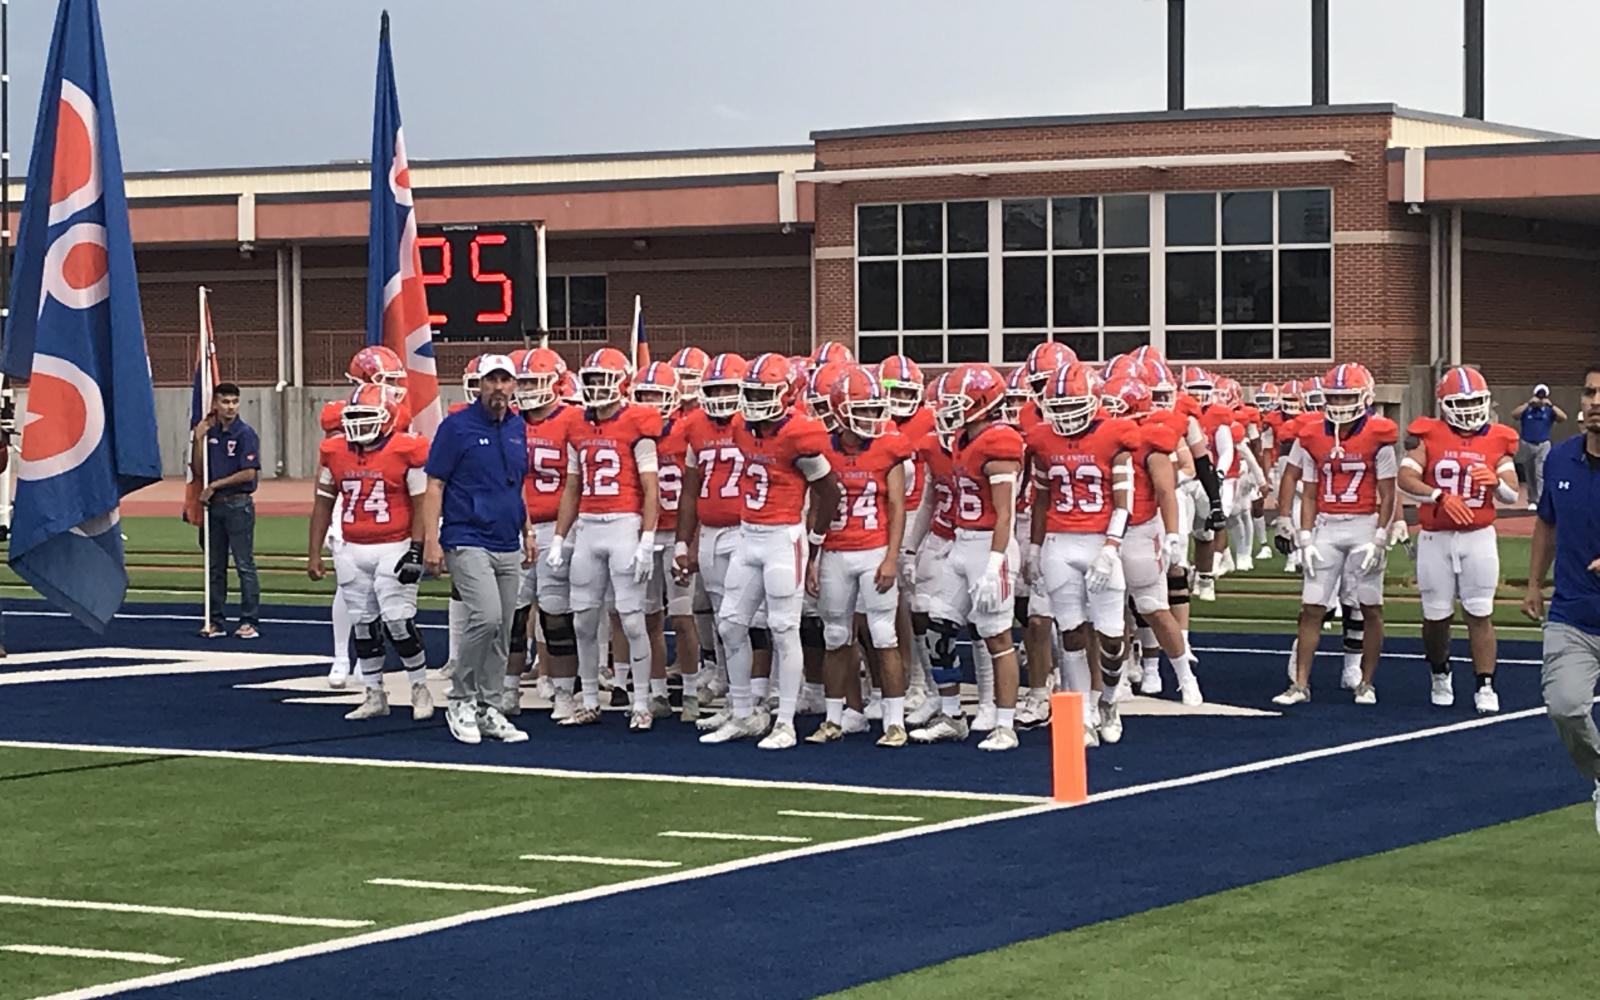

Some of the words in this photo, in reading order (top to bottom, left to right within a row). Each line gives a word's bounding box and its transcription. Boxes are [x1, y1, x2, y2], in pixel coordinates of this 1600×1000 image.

[417, 235, 513, 323] 25
[528, 447, 561, 493] 5
[580, 449, 621, 496] 12
[698, 447, 745, 498] 77
[745, 463, 769, 510] 3
[1048, 465, 1105, 512] 33
[1321, 462, 1367, 503] 17
[1434, 459, 1486, 508] 90
[342, 480, 390, 523] 74
